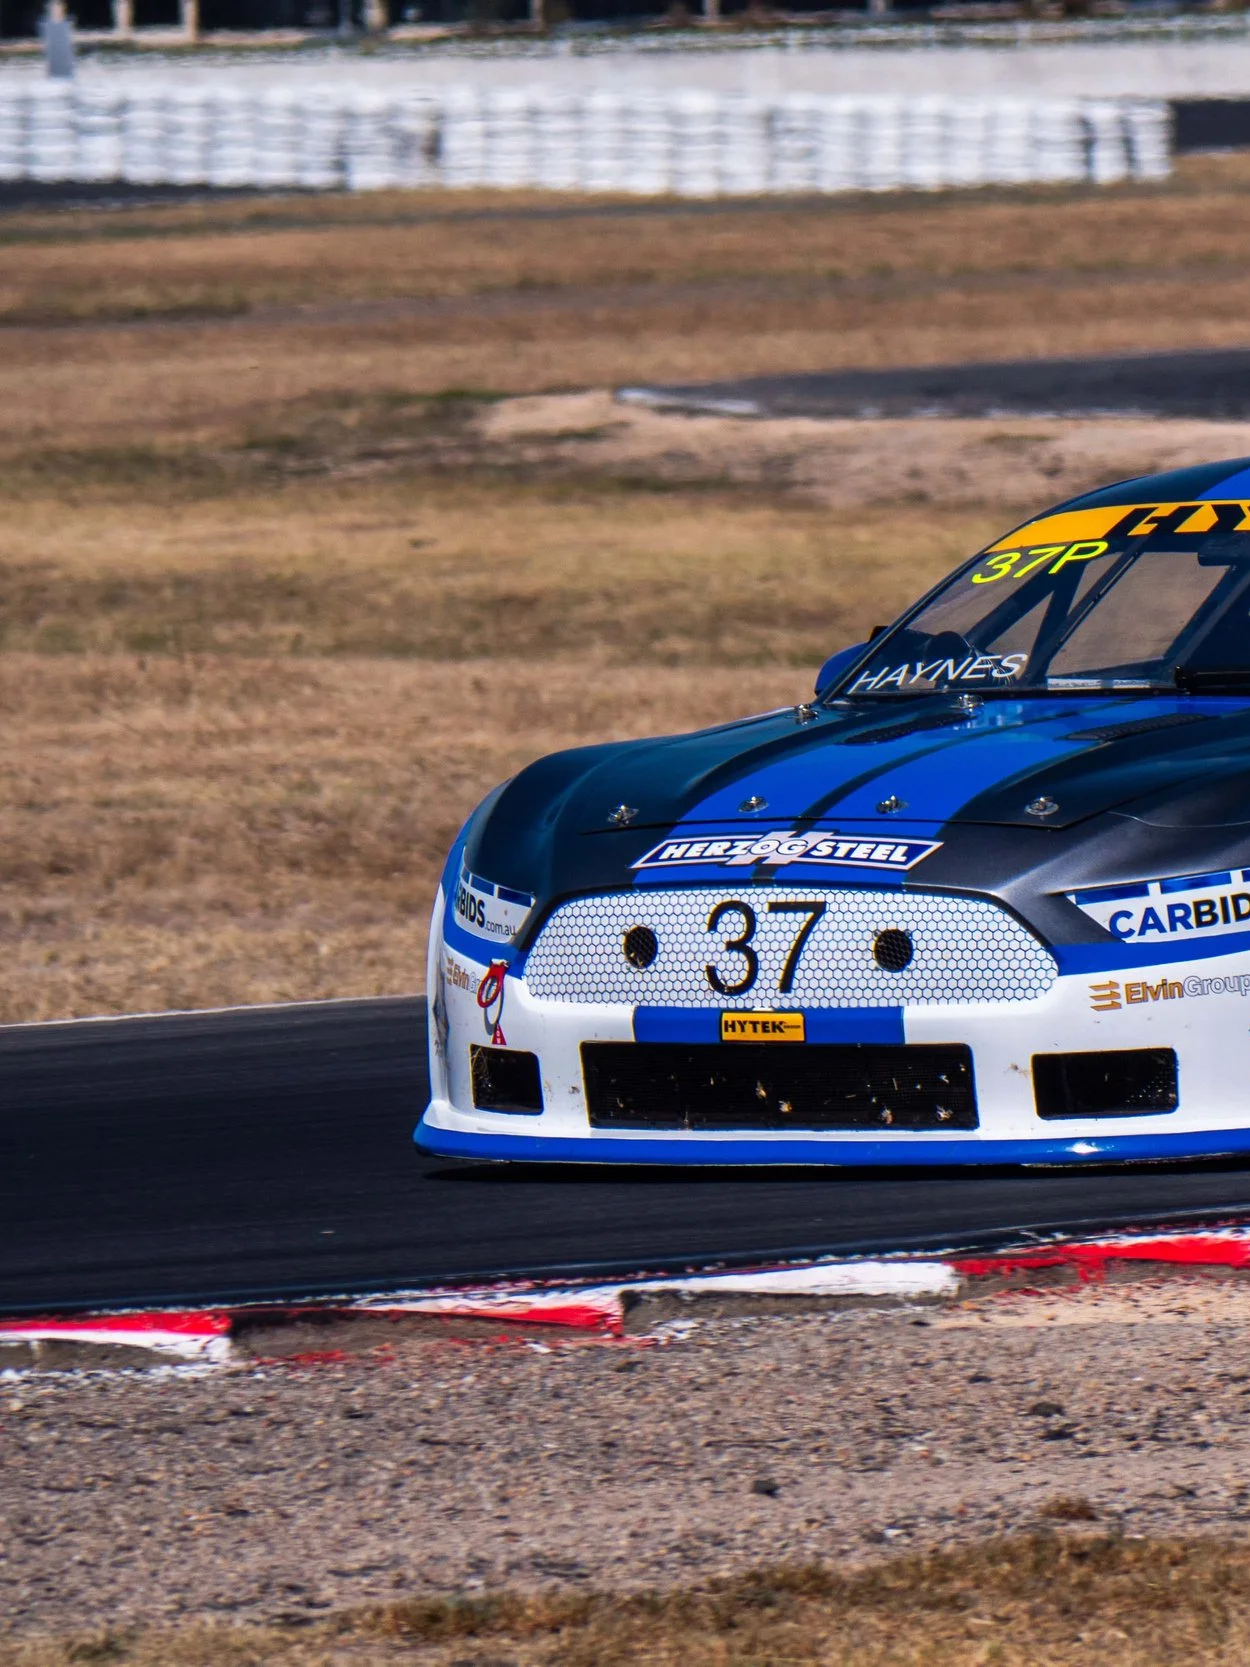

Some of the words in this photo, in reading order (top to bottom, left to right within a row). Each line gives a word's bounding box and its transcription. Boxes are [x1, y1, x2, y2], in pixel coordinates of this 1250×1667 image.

[971, 540, 1109, 584] 37P
[846, 651, 1029, 694] HAYNES
[658, 838, 808, 860] HERZOG
[808, 839, 910, 864] STEEL
[704, 900, 828, 997] 37
[723, 1020, 786, 1034] HYTEK
